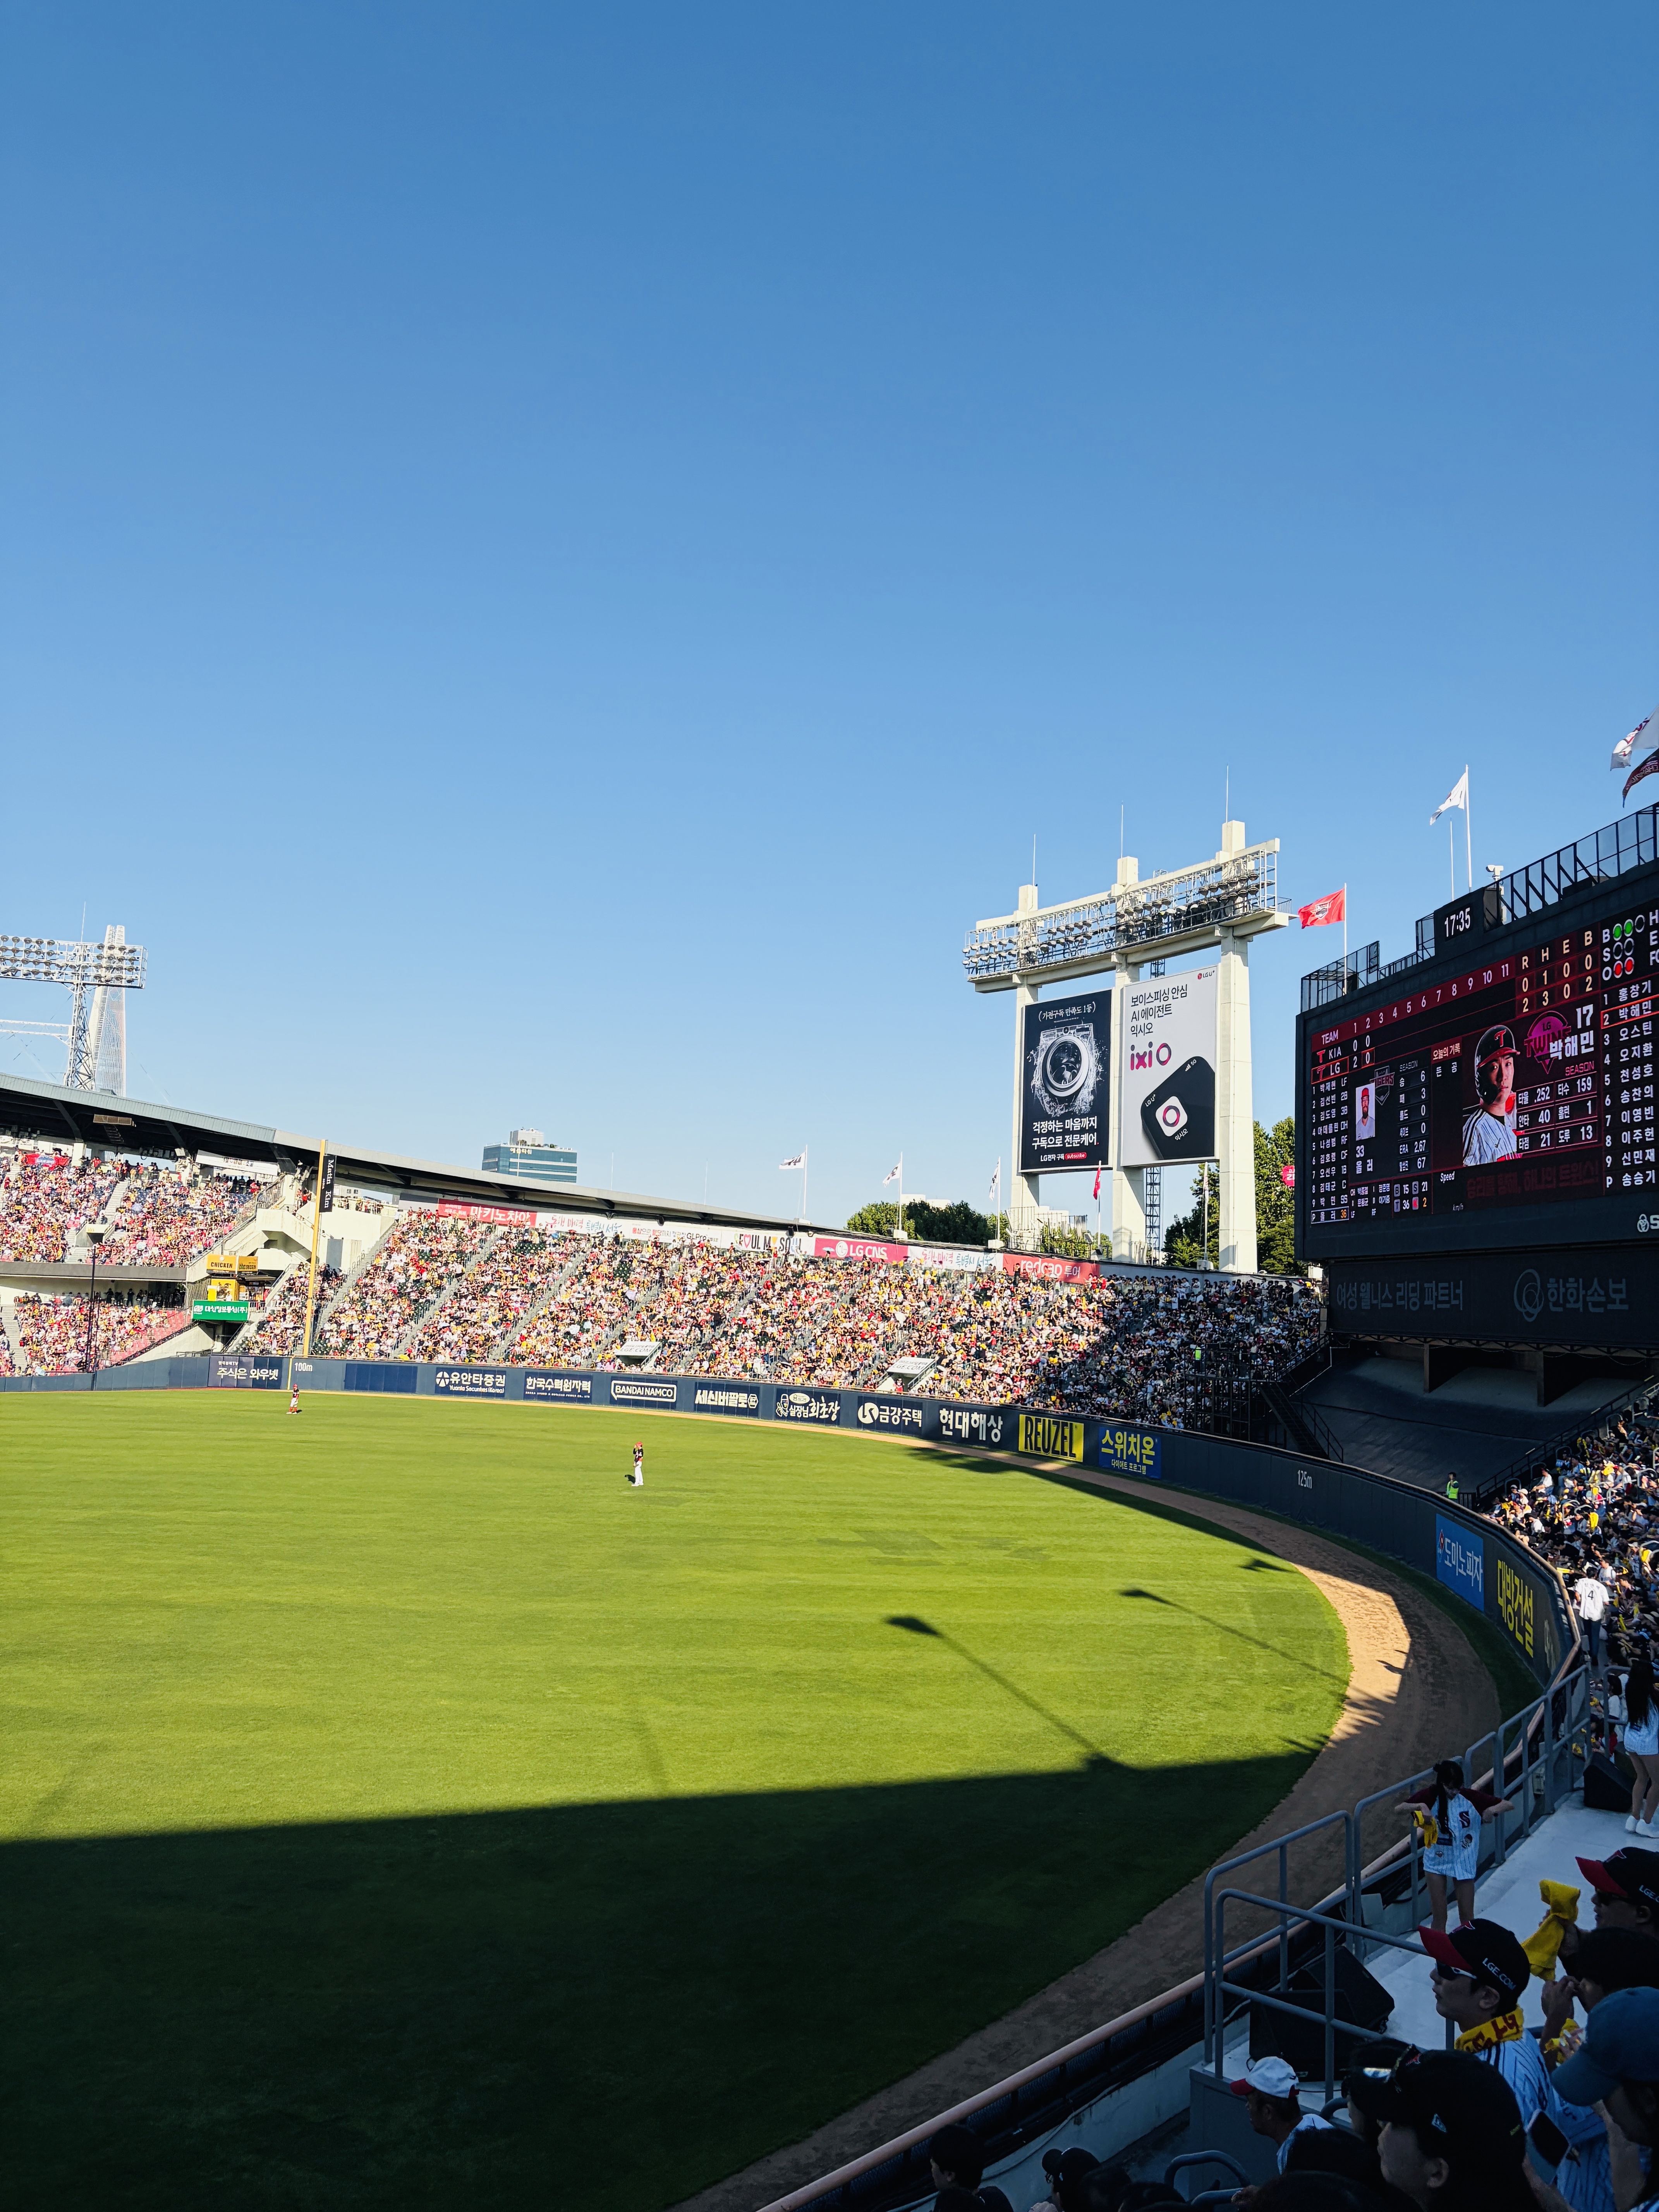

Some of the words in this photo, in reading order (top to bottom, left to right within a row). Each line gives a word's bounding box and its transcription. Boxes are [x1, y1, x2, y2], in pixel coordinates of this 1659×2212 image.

[1444, 908, 1471, 938] 17:35
[1602, 929, 1610, 943] B
[1650, 930, 1658, 946] E
[1603, 948, 1611, 962] S
[1602, 967, 1612, 981] O
[1131, 988, 1170, 1007] 보이스피싱
[1171, 984, 1187, 1000] 안심
[1322, 1029, 1338, 1045] TEAM
[1354, 1023, 1357, 1033] 1
[1366, 1018, 1370, 1029] 2
[1379, 1012, 1383, 1023] 3
[1393, 1007, 1397, 1018] 4
[1407, 1001, 1411, 1013] 5
[1422, 996, 1426, 1007] 6
[1436, 990, 1441, 1002] 7
[1452, 984, 1456, 996] 8
[1468, 978, 1473, 990] 9
[1483, 970, 1492, 984] 10
[1501, 963, 1509, 977] 11
[1522, 956, 1528, 969] R
[1542, 947, 1549, 962] H
[1563, 939, 1570, 953] E
[1585, 931, 1592, 946] B
[1604, 994, 1607, 1005] 1
[1618, 980, 1651, 1002] 홍창기
[1131, 1010, 1139, 1022] AI
[1141, 1004, 1172, 1020] 에이전트
[1329, 1046, 1341, 1060] KIA
[1353, 1040, 1357, 1051] 0
[1366, 1036, 1370, 1047] 0
[1522, 977, 1528, 992] 0
[1543, 970, 1547, 985] 1
[1563, 962, 1570, 977] 0
[1585, 954, 1592, 970] 0
[1576, 1004, 1593, 1029] 17
[1604, 1014, 1609, 1025] 2
[1619, 1000, 1651, 1020] 박해민
[1130, 1022, 1153, 1037] 익시오
[1331, 1063, 1340, 1076] LG
[1353, 1056, 1357, 1068] 2
[1365, 1052, 1370, 1064] 0
[1523, 998, 1528, 1012] 2
[1542, 991, 1548, 1006] 3
[1564, 983, 1570, 999] 0
[1586, 976, 1592, 992] 2
[1604, 1034, 1609, 1045] 3
[1620, 1021, 1652, 1041] 오스틴
[1433, 1047, 1448, 1060] 오늘의
[1449, 1043, 1460, 1054] 기록
[1549, 1030, 1594, 1060] 박해민
[1604, 1054, 1610, 1065] 4
[1620, 1042, 1653, 1062] 오지환
[1565, 1061, 1594, 1076] SEASON
[1605, 1074, 1610, 1085] 5
[1620, 1064, 1653, 1083] 천성호
[1518, 1091, 1528, 1104] 타율
[1534, 1086, 1550, 1103] .252
[1558, 1082, 1569, 1096] 타수
[1577, 1077, 1591, 1093] 159
[1605, 1095, 1611, 1106] 6
[1621, 1085, 1653, 1103] 송찬의
[1519, 1114, 1529, 1127] 안타
[1539, 1109, 1550, 1123] 40
[1559, 1105, 1570, 1120] 홈런
[1587, 1101, 1591, 1114] 1
[1606, 1115, 1611, 1127] 7
[1621, 1106, 1654, 1123] 이영빈
[1033, 1120, 1063, 1134] 걱정하는
[1065, 1116, 1097, 1131] 마음까지
[1032, 1136, 1063, 1150] 구독으로
[1415, 1140, 1426, 1152] 2.67
[1519, 1137, 1529, 1150] 타점
[1541, 1133, 1550, 1147] 21
[1559, 1129, 1570, 1143] 도루
[1581, 1125, 1592, 1140] 13
[1606, 1135, 1611, 1147] 8
[1621, 1127, 1654, 1144] 이주헌
[1356, 1145, 1364, 1158] 33
[1606, 1156, 1612, 1167] 9
[1622, 1148, 1655, 1166] 신민재
[1441, 1171, 1455, 1183] Speed
[1606, 1176, 1613, 1188] P
[1622, 1170, 1655, 1186] 송승기
[1403, 1184, 1409, 1194] 15
[1422, 1182, 1427, 1192] 21
[470, 1206, 530, 1224] 마키노차야
[850, 1245, 864, 1257] LG
[865, 1245, 887, 1258] CNS
[1064, 1266, 1080, 1278] 투어
[1337, 1282, 1357, 1310] 여성
[1360, 1282, 1393, 1309] 웰니스
[1396, 1281, 1420, 1310] 리딩
[1424, 1280, 1463, 1310] 파트너
[1547, 1277, 1629, 1313] 한화손보
[217, 1367, 247, 1379] 주식은
[249, 1369, 278, 1380] 와우넷
[295, 1362, 313, 1372] 100m
[450, 1372, 505, 1387] 유안타증권
[526, 1376, 591, 1393] 한국수력원자력
[615, 1385, 644, 1395] BANDAI
[645, 1387, 673, 1397] NAMCO
[695, 1389, 748, 1408] 세신버팔로
[789, 1405, 809, 1418] 실장님
[809, 1396, 840, 1421] 회초장
[879, 1406, 922, 1427] 금강주택
[939, 1408, 1003, 1443] 현대해상
[1024, 1416, 1077, 1459] REUZEL
[1101, 1430, 1155, 1465] 스위치온
[1111, 1459, 1128, 1470] 다이어트
[1297, 1470, 1312, 1489] 125m
[1444, 1537, 1484, 1592] 도미노피자
[1498, 1559, 1534, 1658] 대방건설
[1482, 1958, 1517, 1990] LGE.COM
[1491, 2014, 1520, 2040] LG
